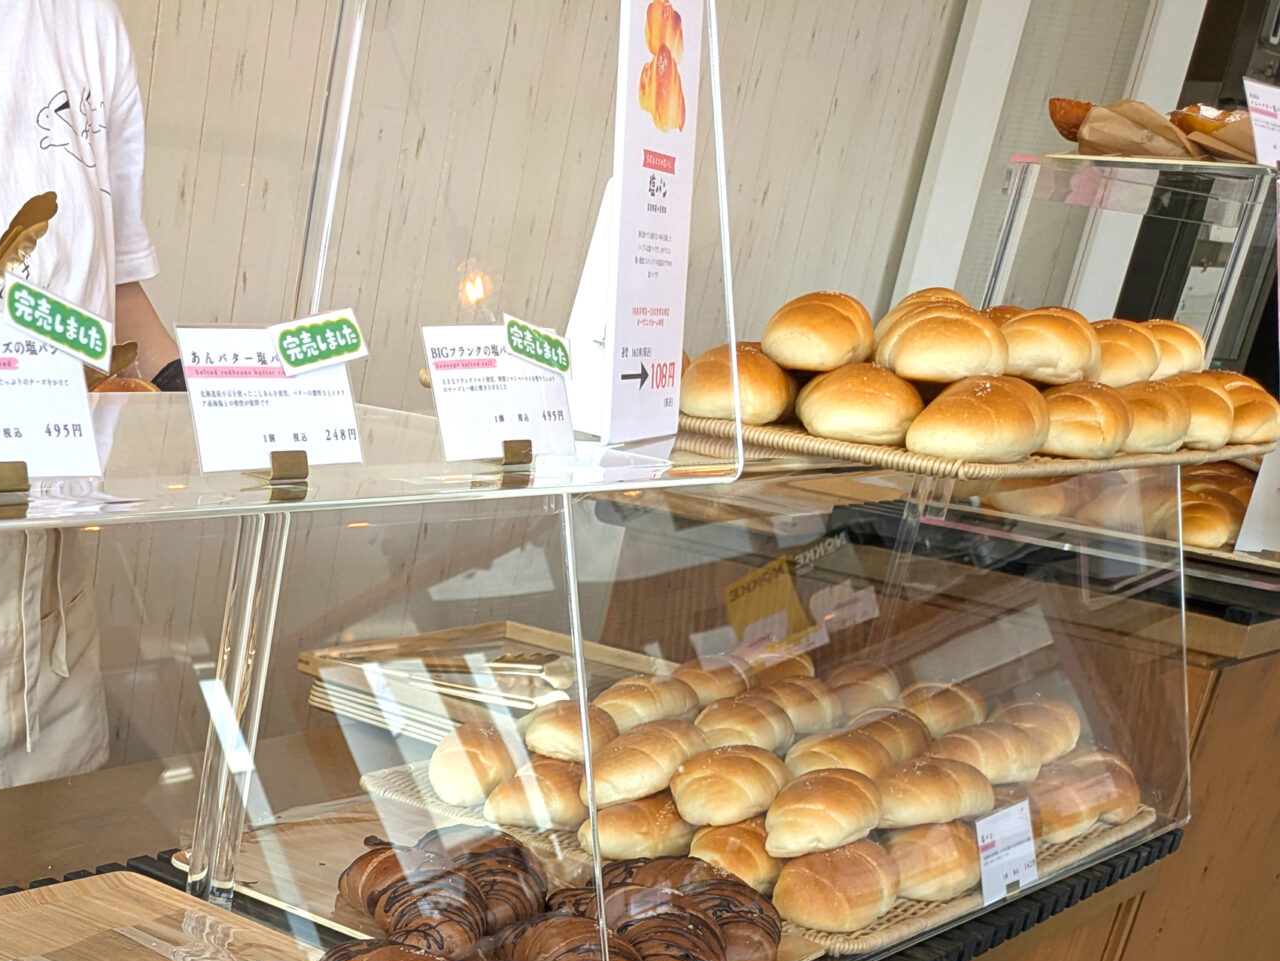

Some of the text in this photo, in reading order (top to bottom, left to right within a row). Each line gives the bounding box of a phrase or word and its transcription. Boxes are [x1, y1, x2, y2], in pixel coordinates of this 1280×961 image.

[13, 288, 104, 353] 完売しました
[282, 324, 358, 362] 完売しました
[509, 325, 568, 367] 完売しました
[650, 361, 676, 390] 108円
[542, 410, 565, 422] 495円
[3, 427, 23, 438] 税込
[44, 424, 83, 438] 495円
[293, 432, 308, 442] 税込
[325, 428, 357, 441] 248円
